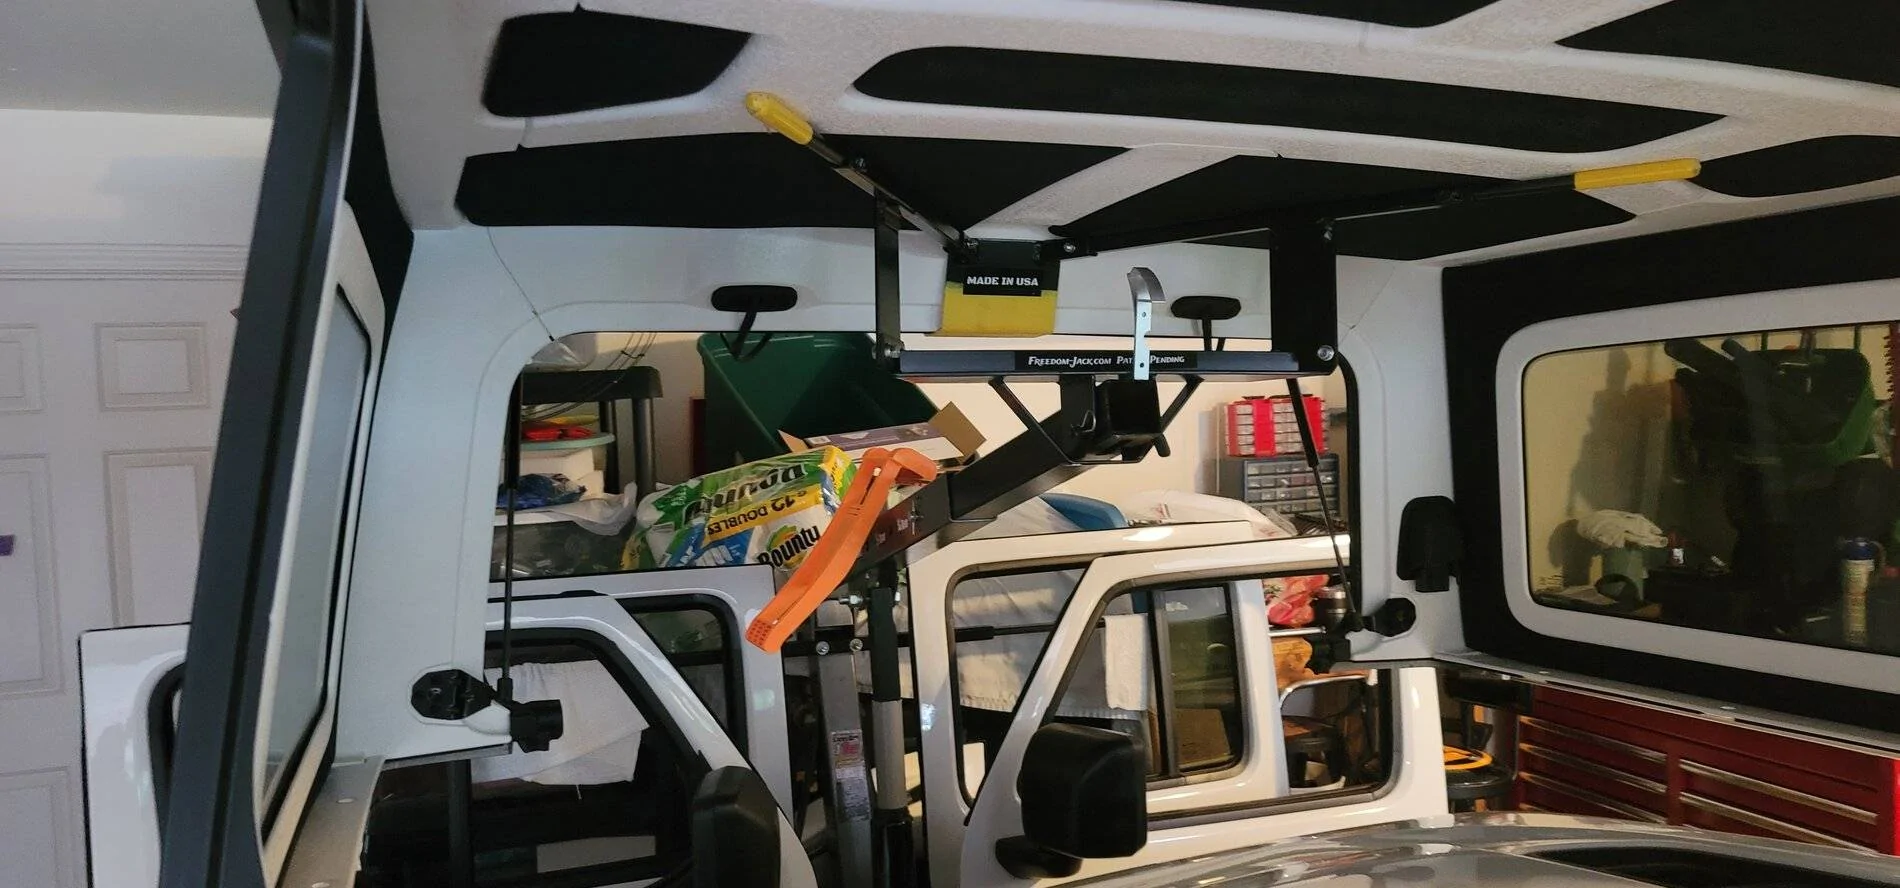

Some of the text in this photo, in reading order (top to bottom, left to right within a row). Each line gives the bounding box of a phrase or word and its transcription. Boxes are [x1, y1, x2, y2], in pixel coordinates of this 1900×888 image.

[966, 276, 1039, 286] MADE IN USA
[1150, 355, 1185, 364] PENDING
[707, 507, 768, 535] DOUBLES
